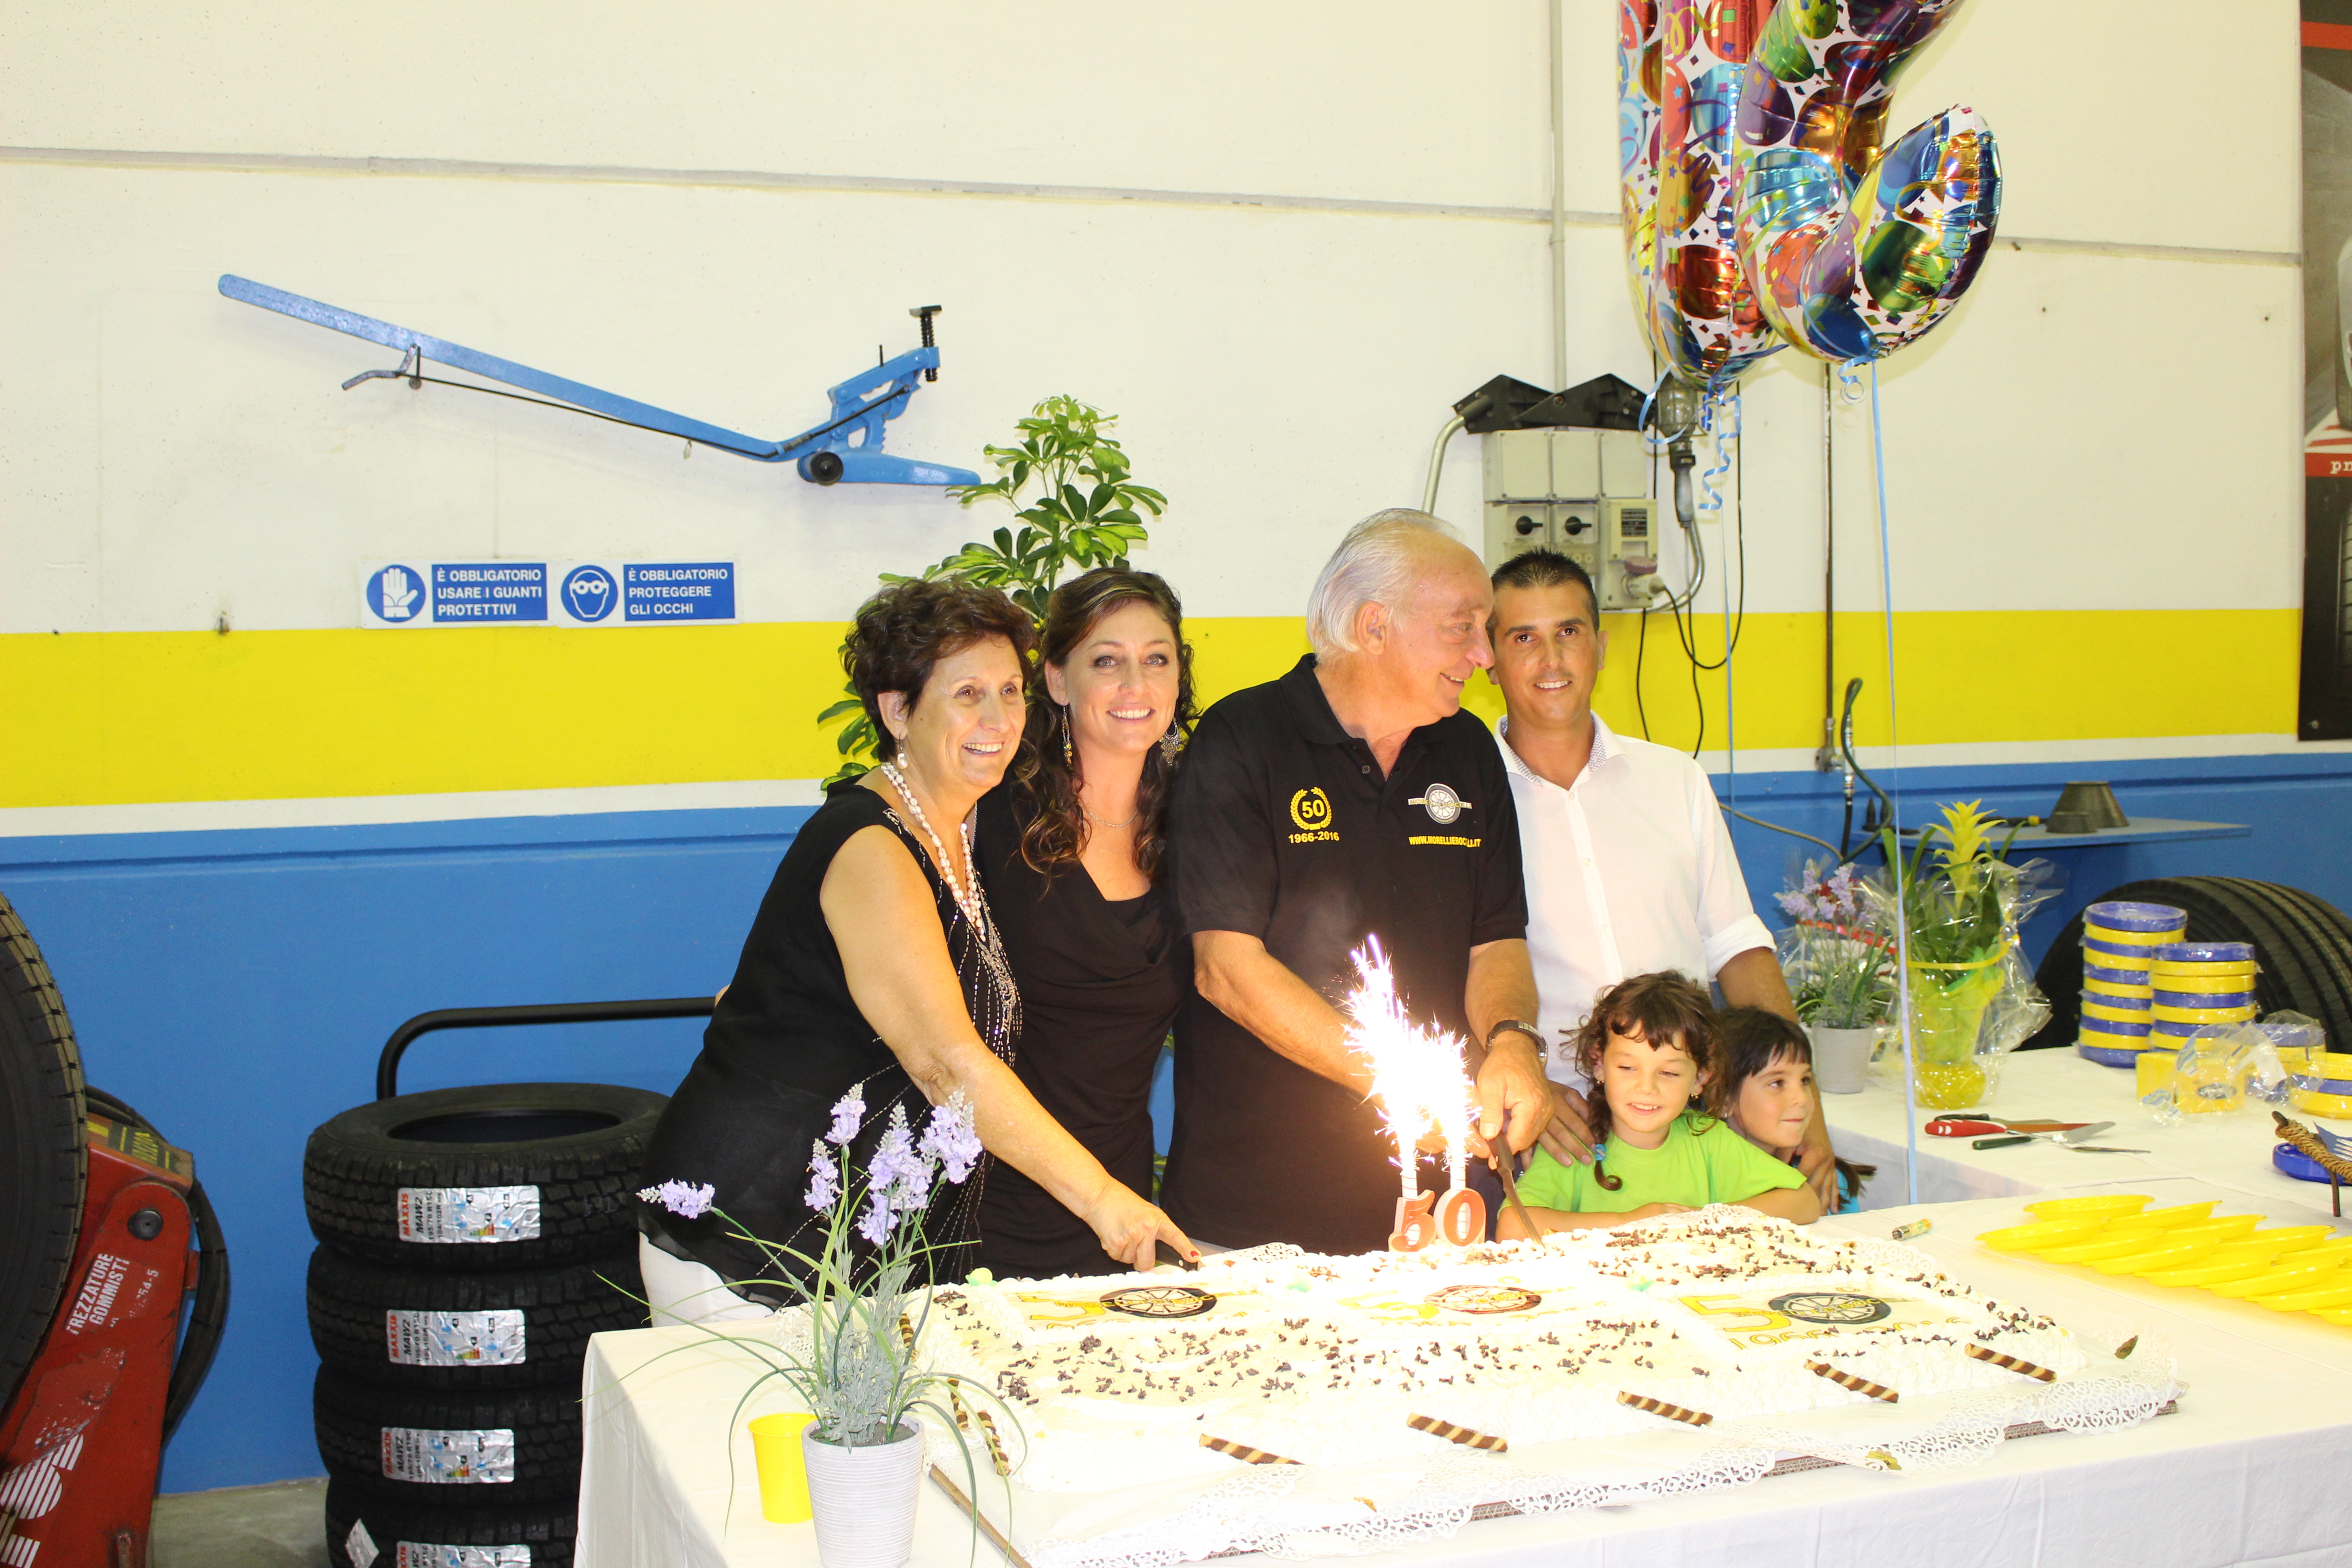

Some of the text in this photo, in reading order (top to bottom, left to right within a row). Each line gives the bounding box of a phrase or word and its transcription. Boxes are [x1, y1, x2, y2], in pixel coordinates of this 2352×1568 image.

[449, 569, 541, 582] OBBLIGATORIO
[639, 568, 728, 582] OBBLIGATORIO
[437, 586, 542, 599] USARE I GUANTI
[629, 586, 712, 598] PROTEGGERE
[438, 603, 517, 617] PROTETTIVI
[629, 603, 694, 615] GLI OCCHI
[1302, 799, 1325, 818] 50
[1288, 831, 1340, 844] 1966-2016
[402, 1193, 411, 1236] MAXXIS
[415, 1197, 424, 1234] MAW2
[89, 1257, 130, 1325] GOMMISTI
[389, 1315, 400, 1358] MAXXIS
[402, 1319, 412, 1355] MAW2
